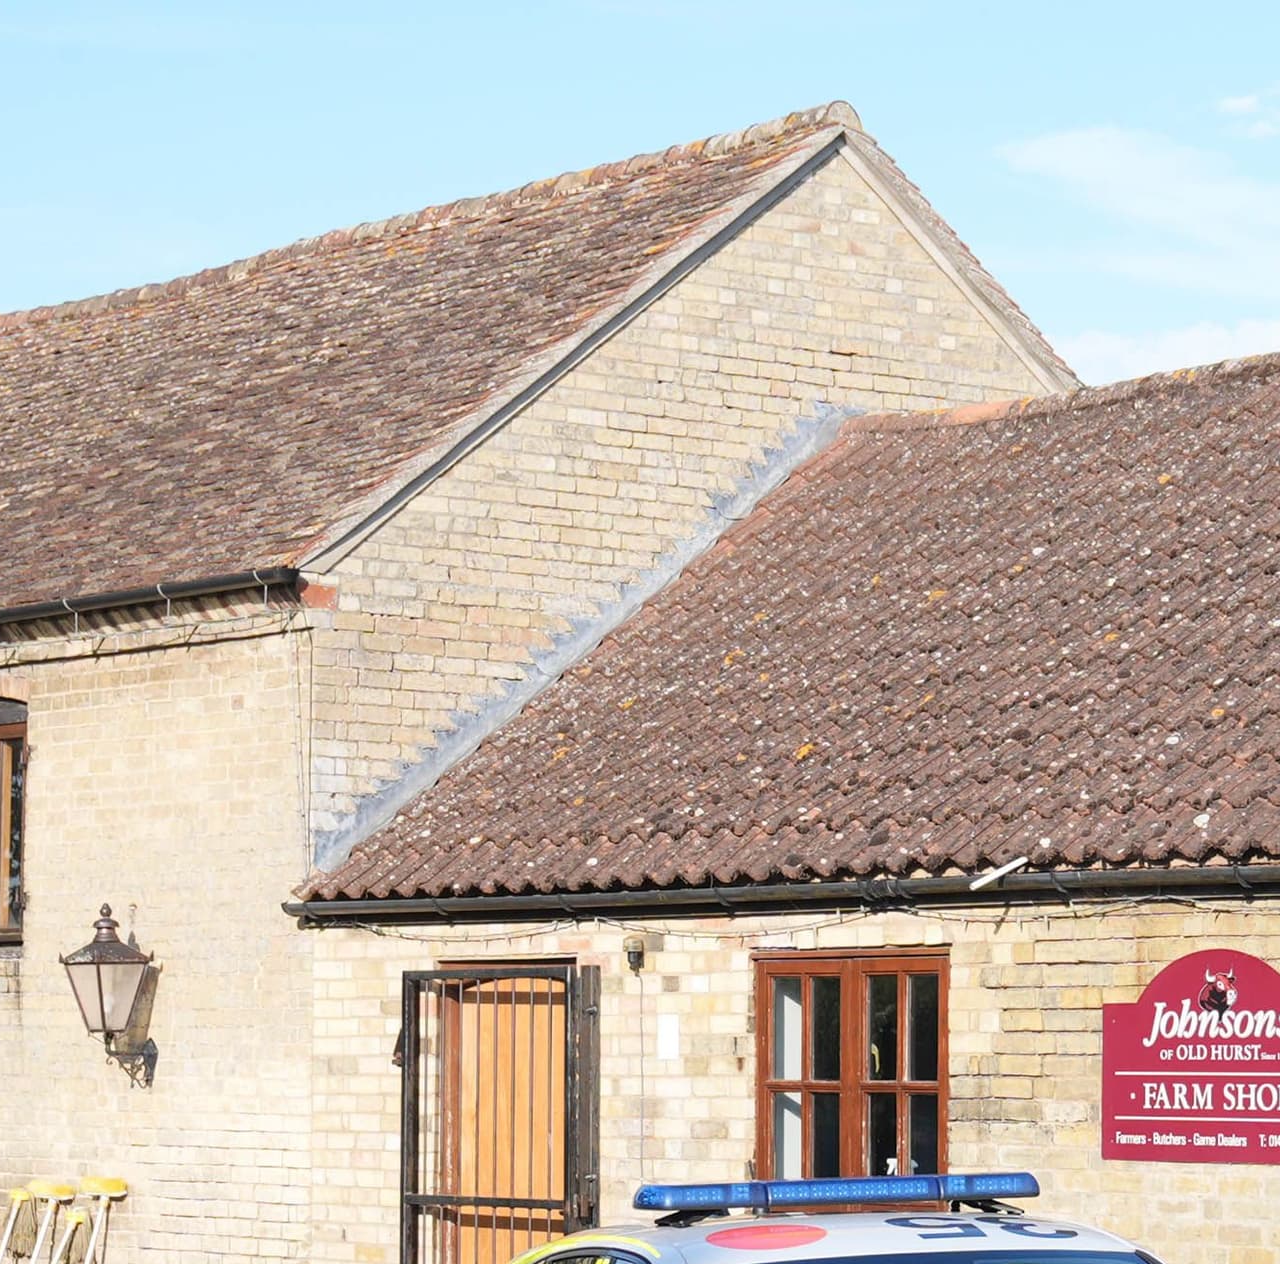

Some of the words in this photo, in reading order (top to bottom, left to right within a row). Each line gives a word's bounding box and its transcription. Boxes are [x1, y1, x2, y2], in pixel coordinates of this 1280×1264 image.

[1159, 1049, 1174, 1061] OF
[1175, 1044, 1208, 1061] OLD
[1210, 1044, 1261, 1061] HURST
[1142, 1082, 1214, 1111] FARM
[1115, 1131, 1147, 1145] Farmers
[1153, 1131, 1187, 1146] Butchers
[1193, 1132, 1217, 1146] Game
[1217, 1133, 1248, 1147] Dealers
